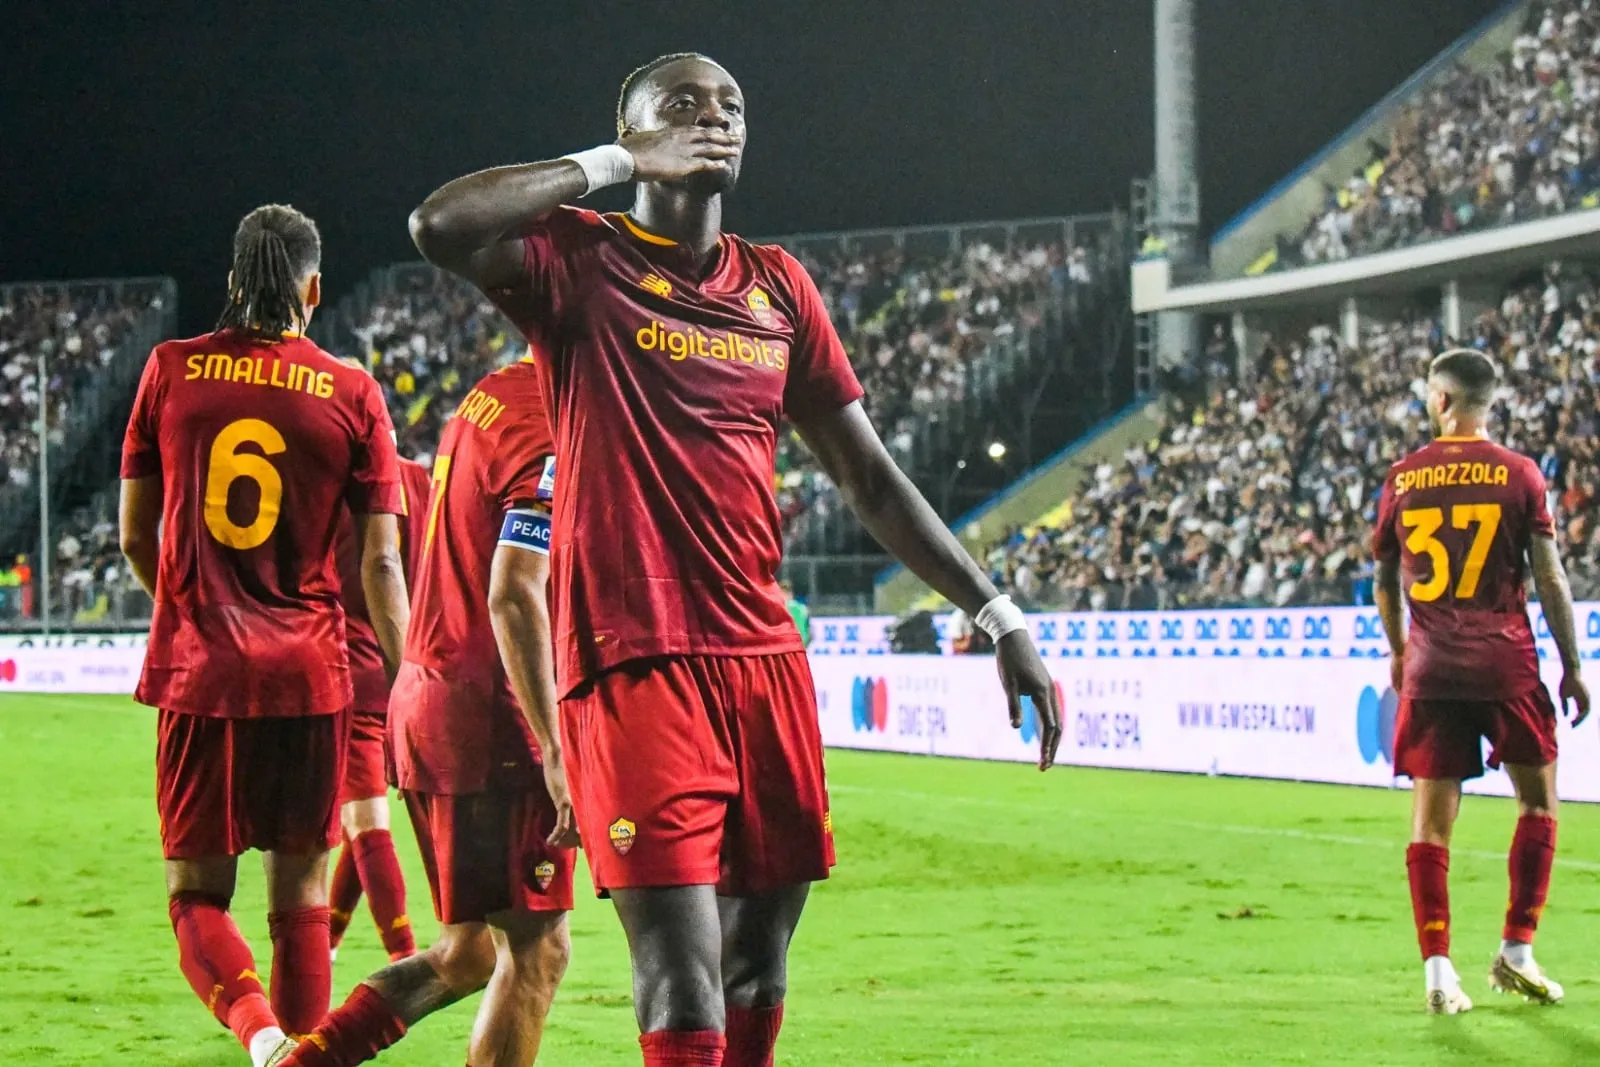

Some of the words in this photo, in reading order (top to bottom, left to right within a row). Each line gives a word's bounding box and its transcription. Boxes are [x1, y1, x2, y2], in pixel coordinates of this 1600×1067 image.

[636, 320, 785, 371] digitalbits
[185, 354, 334, 399] SMALLING
[203, 418, 287, 550] 6
[1395, 462, 1508, 496] SPINAZZOLA
[511, 520, 551, 542] PEAC
[1402, 503, 1501, 602] 37
[1114, 712, 1142, 750] SPA
[1178, 702, 1316, 734] WWW.GMGSPA.COM
